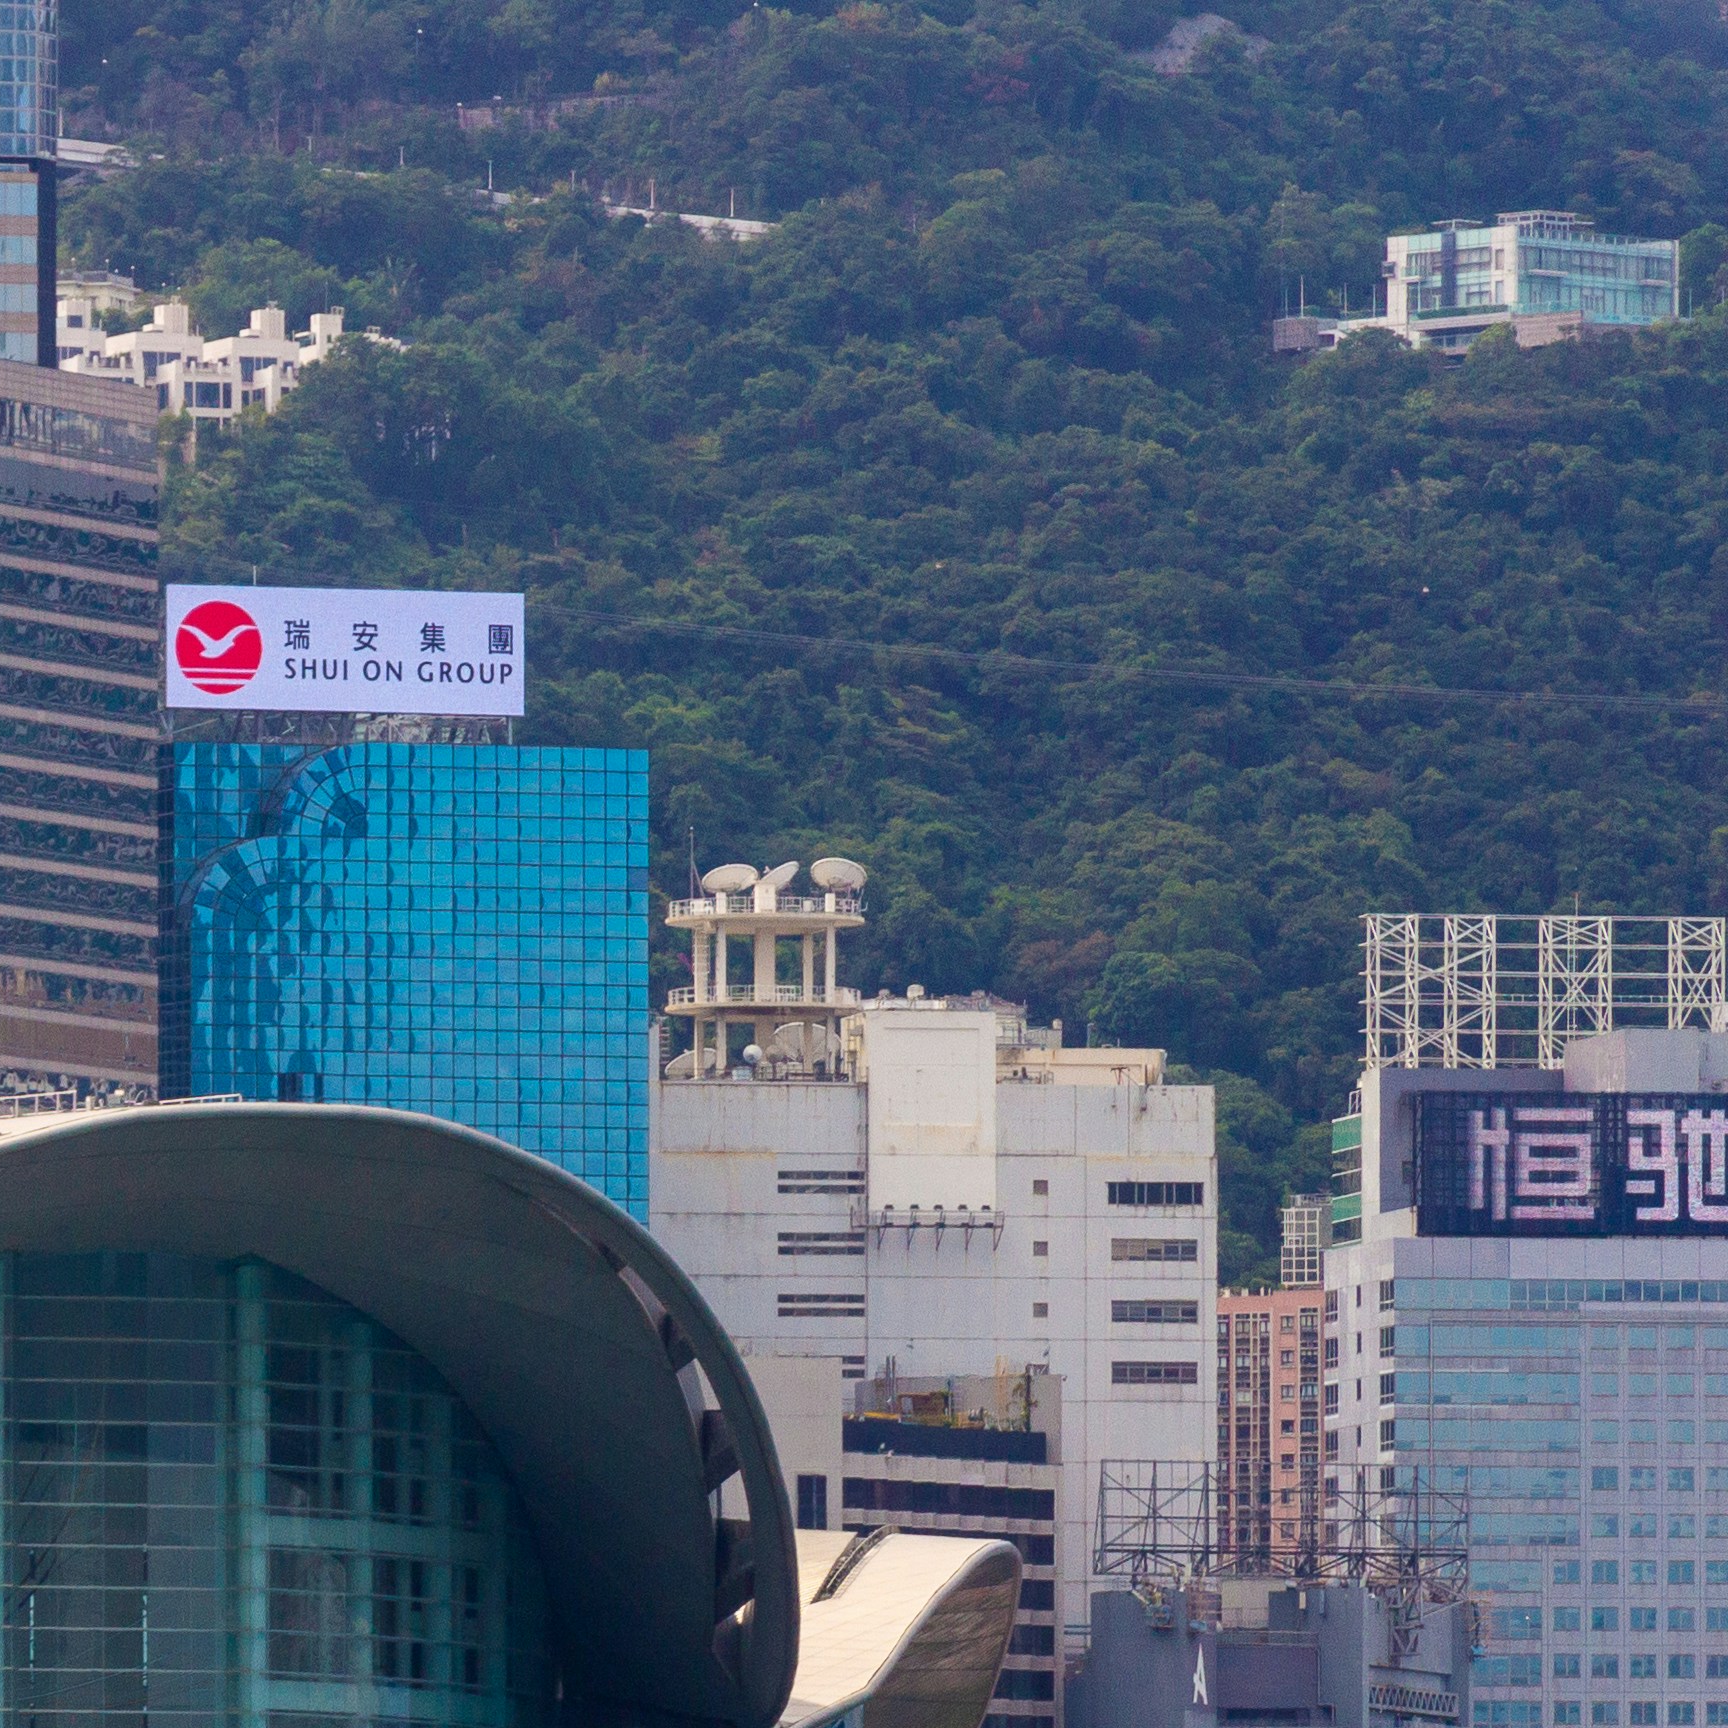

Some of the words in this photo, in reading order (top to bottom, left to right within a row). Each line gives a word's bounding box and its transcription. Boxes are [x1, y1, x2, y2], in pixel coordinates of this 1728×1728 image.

[284, 619, 513, 655] 瑞安集團
[284, 658, 348, 681] SHUI
[362, 659, 403, 682] ON
[417, 661, 513, 684] GROUP
